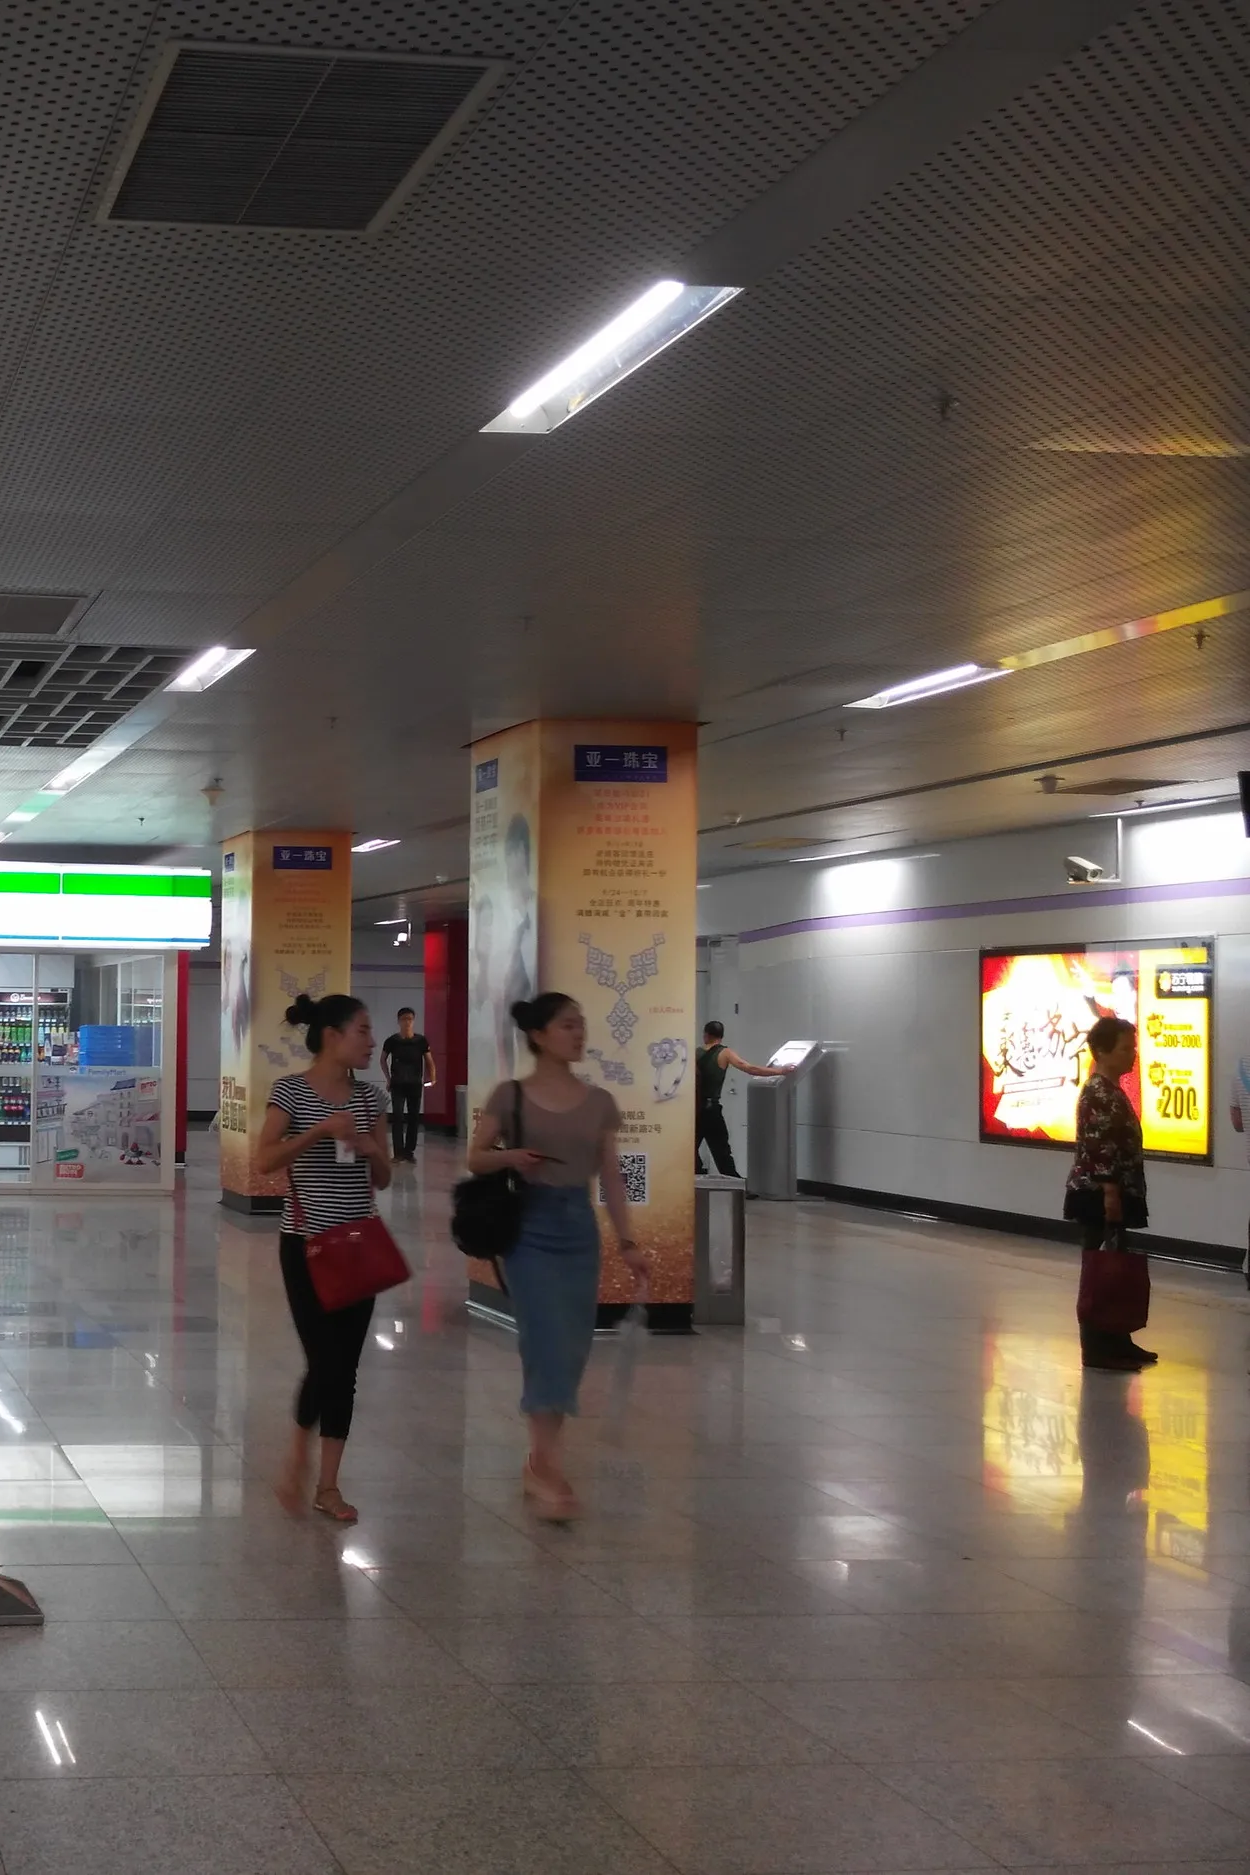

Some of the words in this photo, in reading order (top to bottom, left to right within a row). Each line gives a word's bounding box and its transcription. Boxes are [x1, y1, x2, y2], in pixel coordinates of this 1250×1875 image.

[586, 751, 659, 769] 亚一珠宝
[280, 849, 327, 862] 亚一珠宝
[1161, 1085, 1197, 1120] 200
[616, 1123, 662, 1134] 园新路2号
